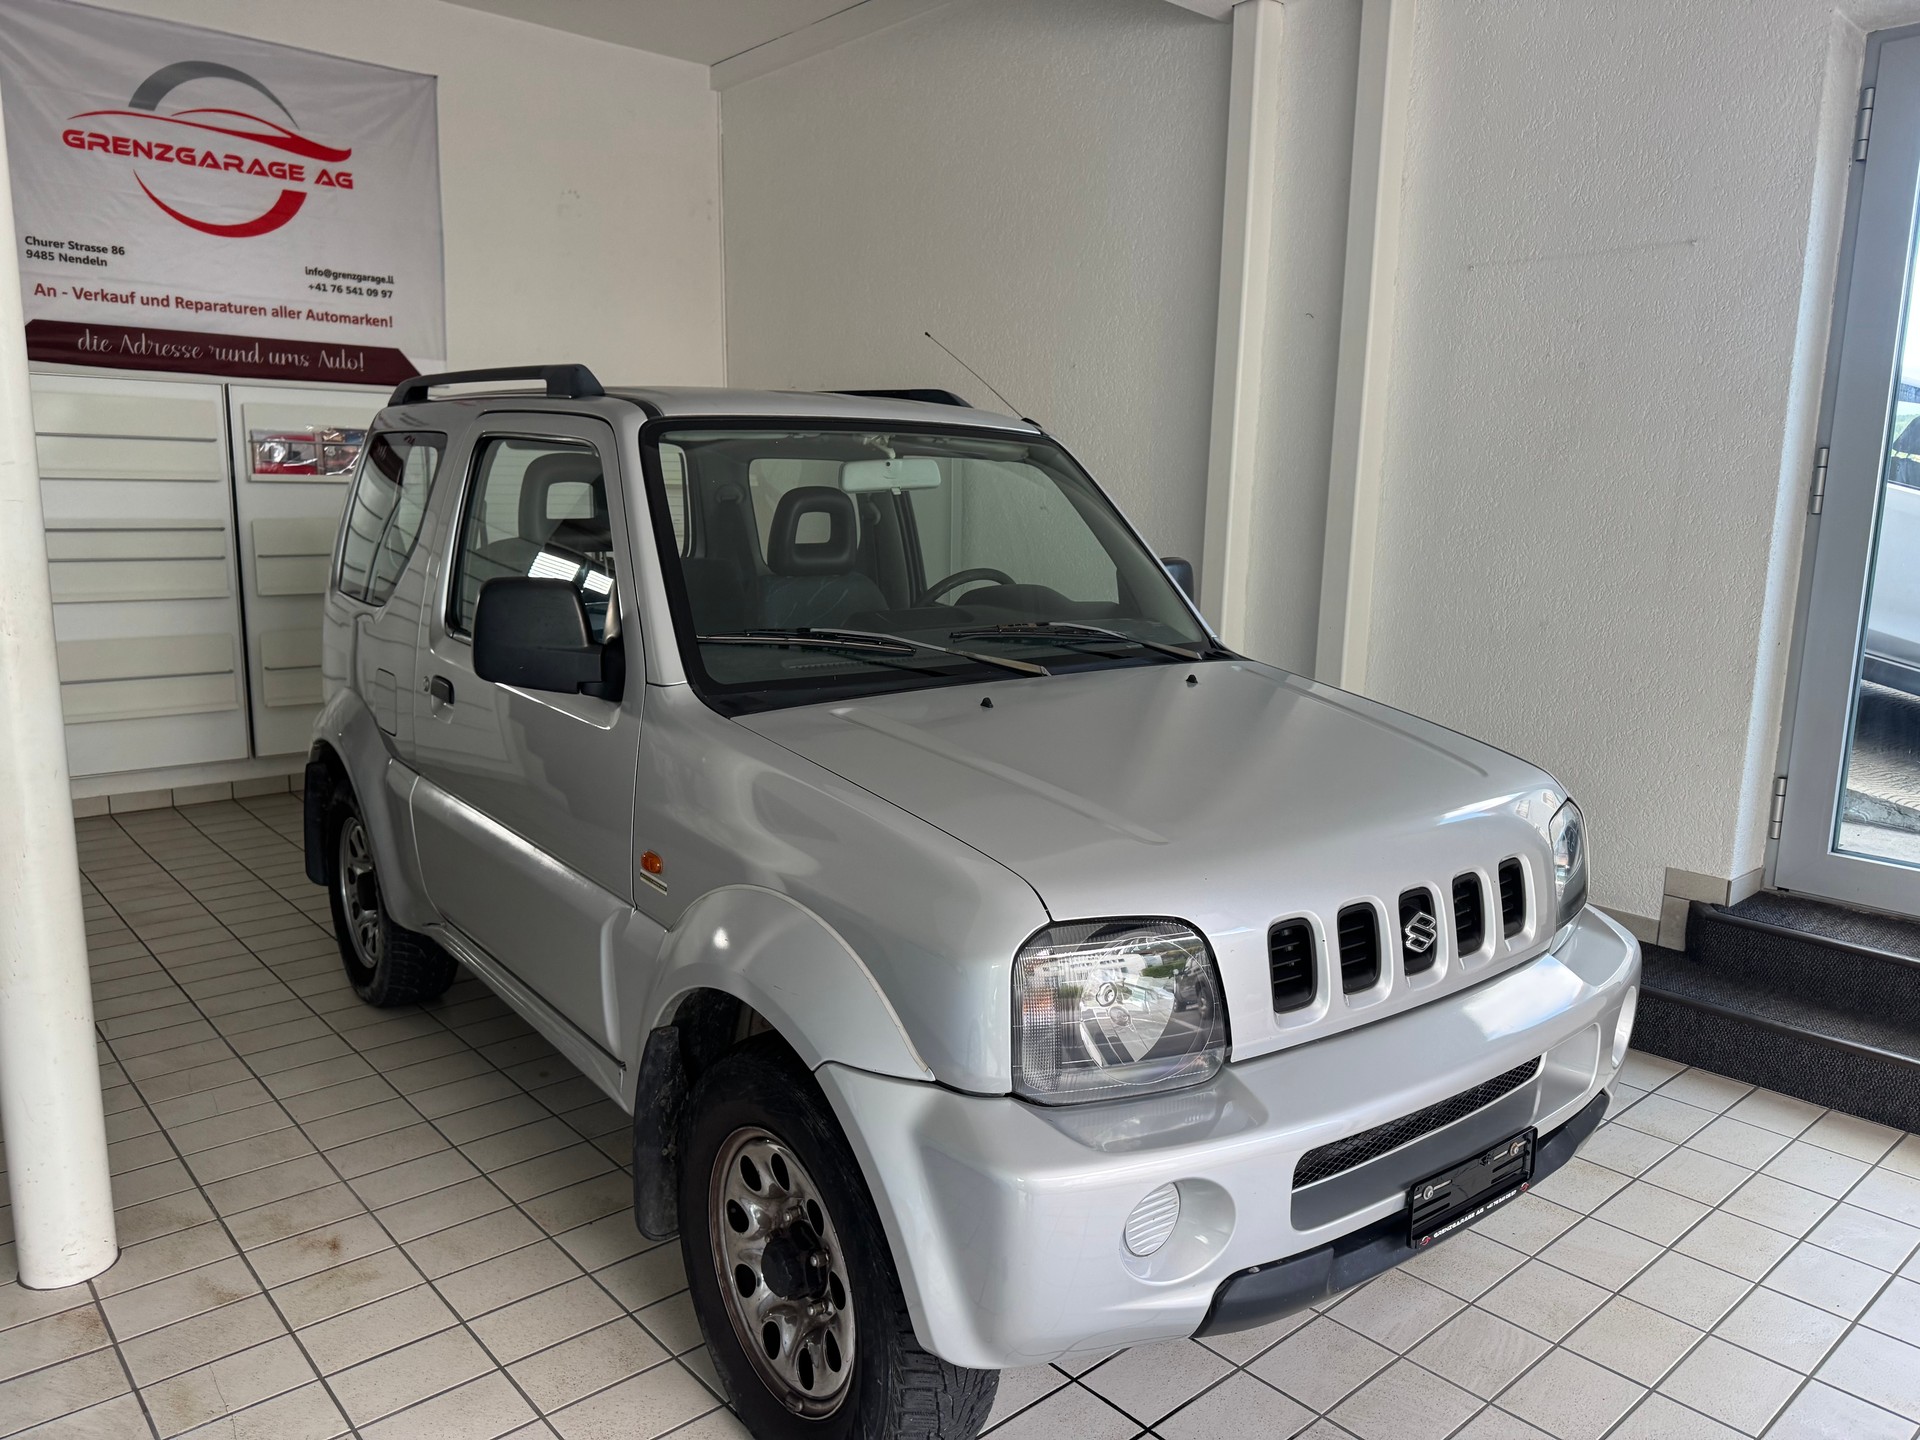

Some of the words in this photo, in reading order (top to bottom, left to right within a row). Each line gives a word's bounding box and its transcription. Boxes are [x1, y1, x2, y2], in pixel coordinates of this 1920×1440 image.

[62, 129, 306, 182] GRENZGARAGE
[314, 169, 354, 190] AG
[24, 235, 65, 249] Churer
[68, 240, 109, 254] Strasse
[111, 246, 126, 256] 86
[26, 249, 55, 261] 9485
[59, 254, 108, 267] Nendeln
[304, 266, 395, 285] info@grenzgarage.li
[308, 283, 328, 293] +41
[330, 284, 343, 294] 76
[345, 286, 364, 296] 541
[366, 288, 379, 298] 09
[381, 290, 393, 299] 97
[34, 283, 57, 298] An
[72, 287, 136, 305] Verkauf
[140, 295, 171, 308] und
[175, 296, 267, 317] Reparaturen
[271, 305, 302, 320] aller
[306, 309, 393, 328] Automarken!
[77, 328, 113, 353] die
[119, 333, 204, 360] Adresse
[208, 342, 264, 364] rund
[268, 350, 312, 367] ums
[318, 348, 365, 373] Auto!
